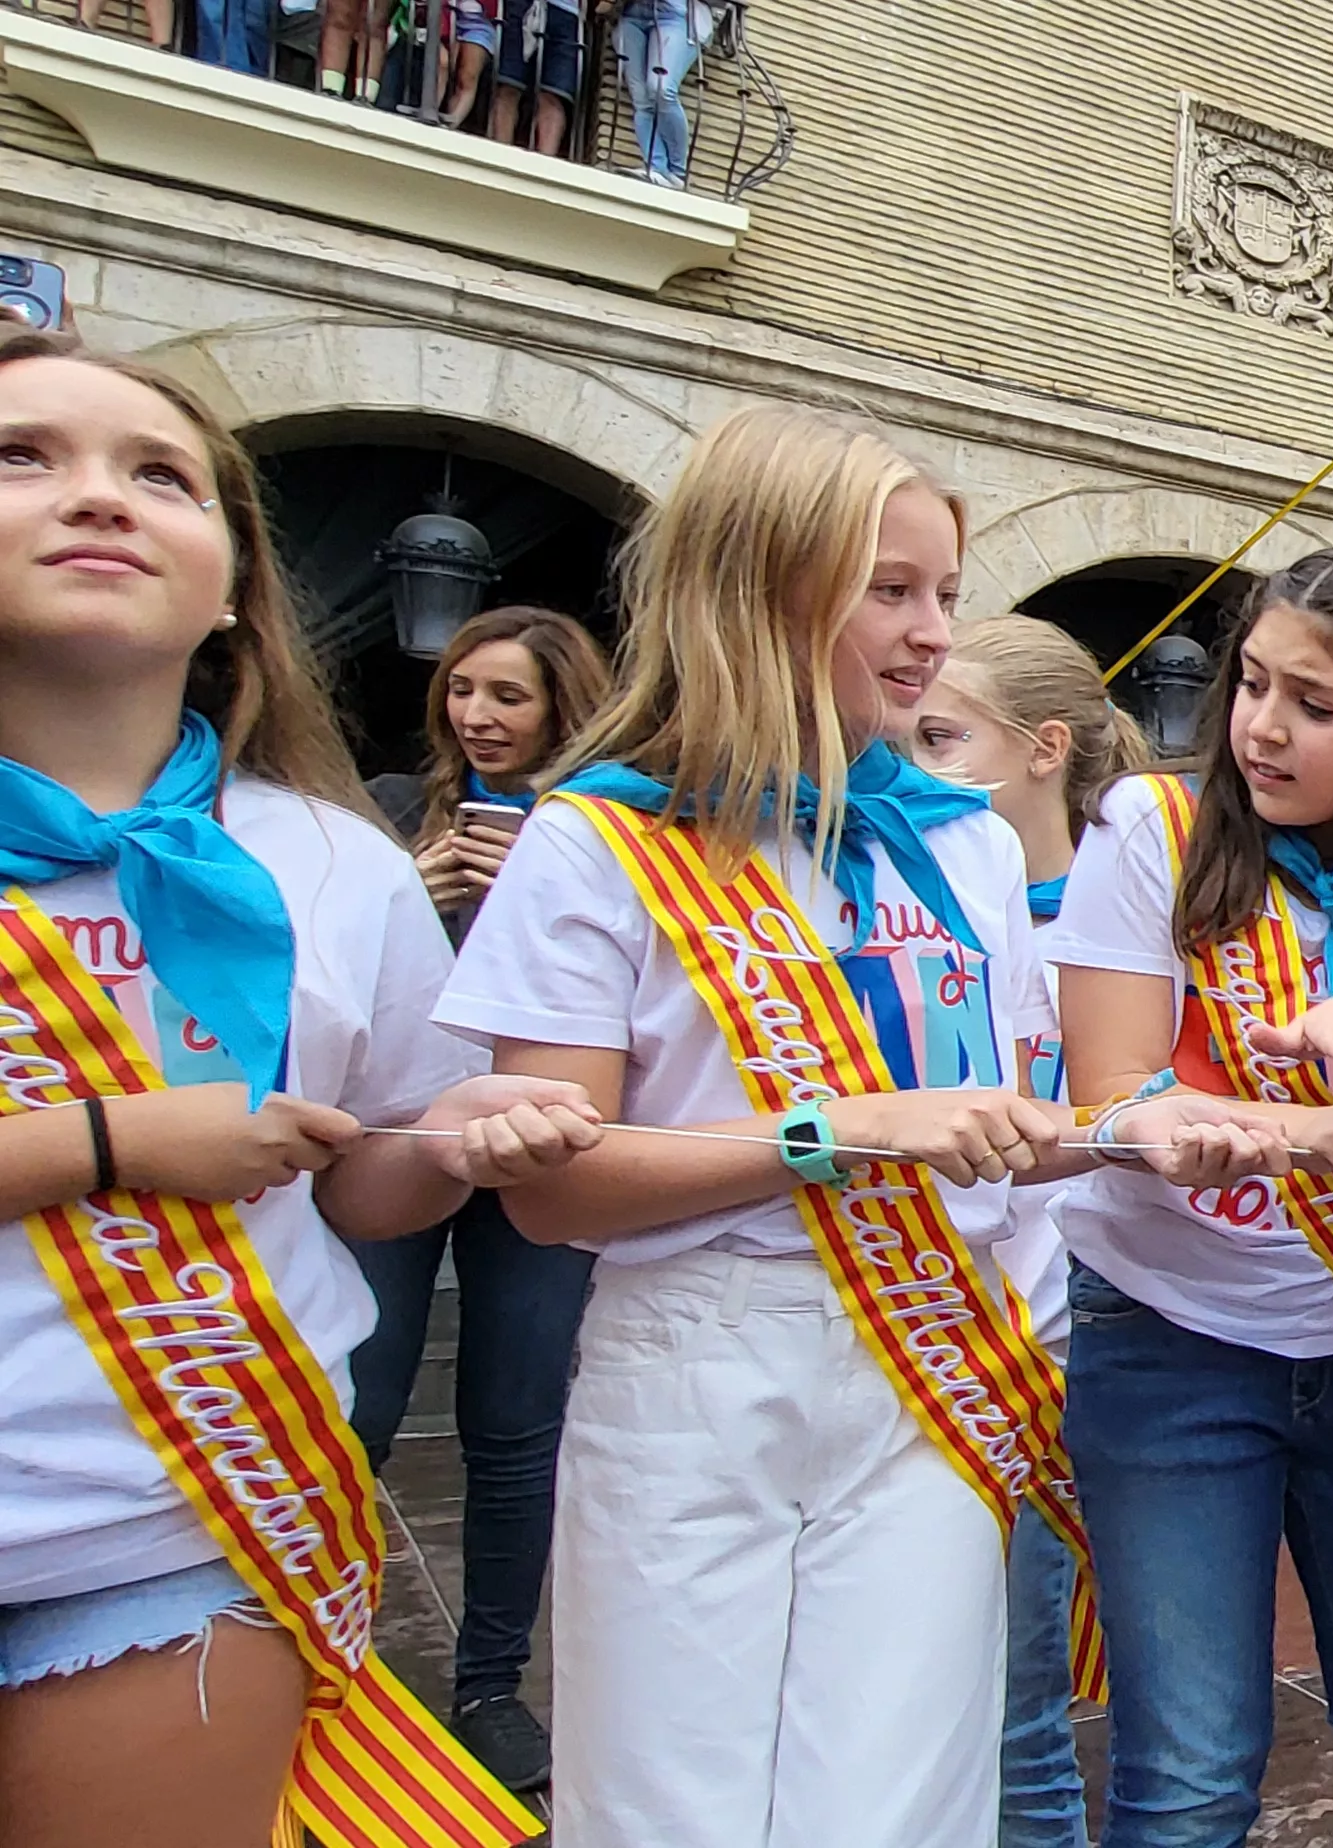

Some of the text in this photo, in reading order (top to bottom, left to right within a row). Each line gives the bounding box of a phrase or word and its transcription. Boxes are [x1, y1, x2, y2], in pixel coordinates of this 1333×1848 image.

[833, 945, 1003, 1090] AN
[117, 1262, 327, 1576] Monzón
[876, 1251, 1031, 1496] Monzón
